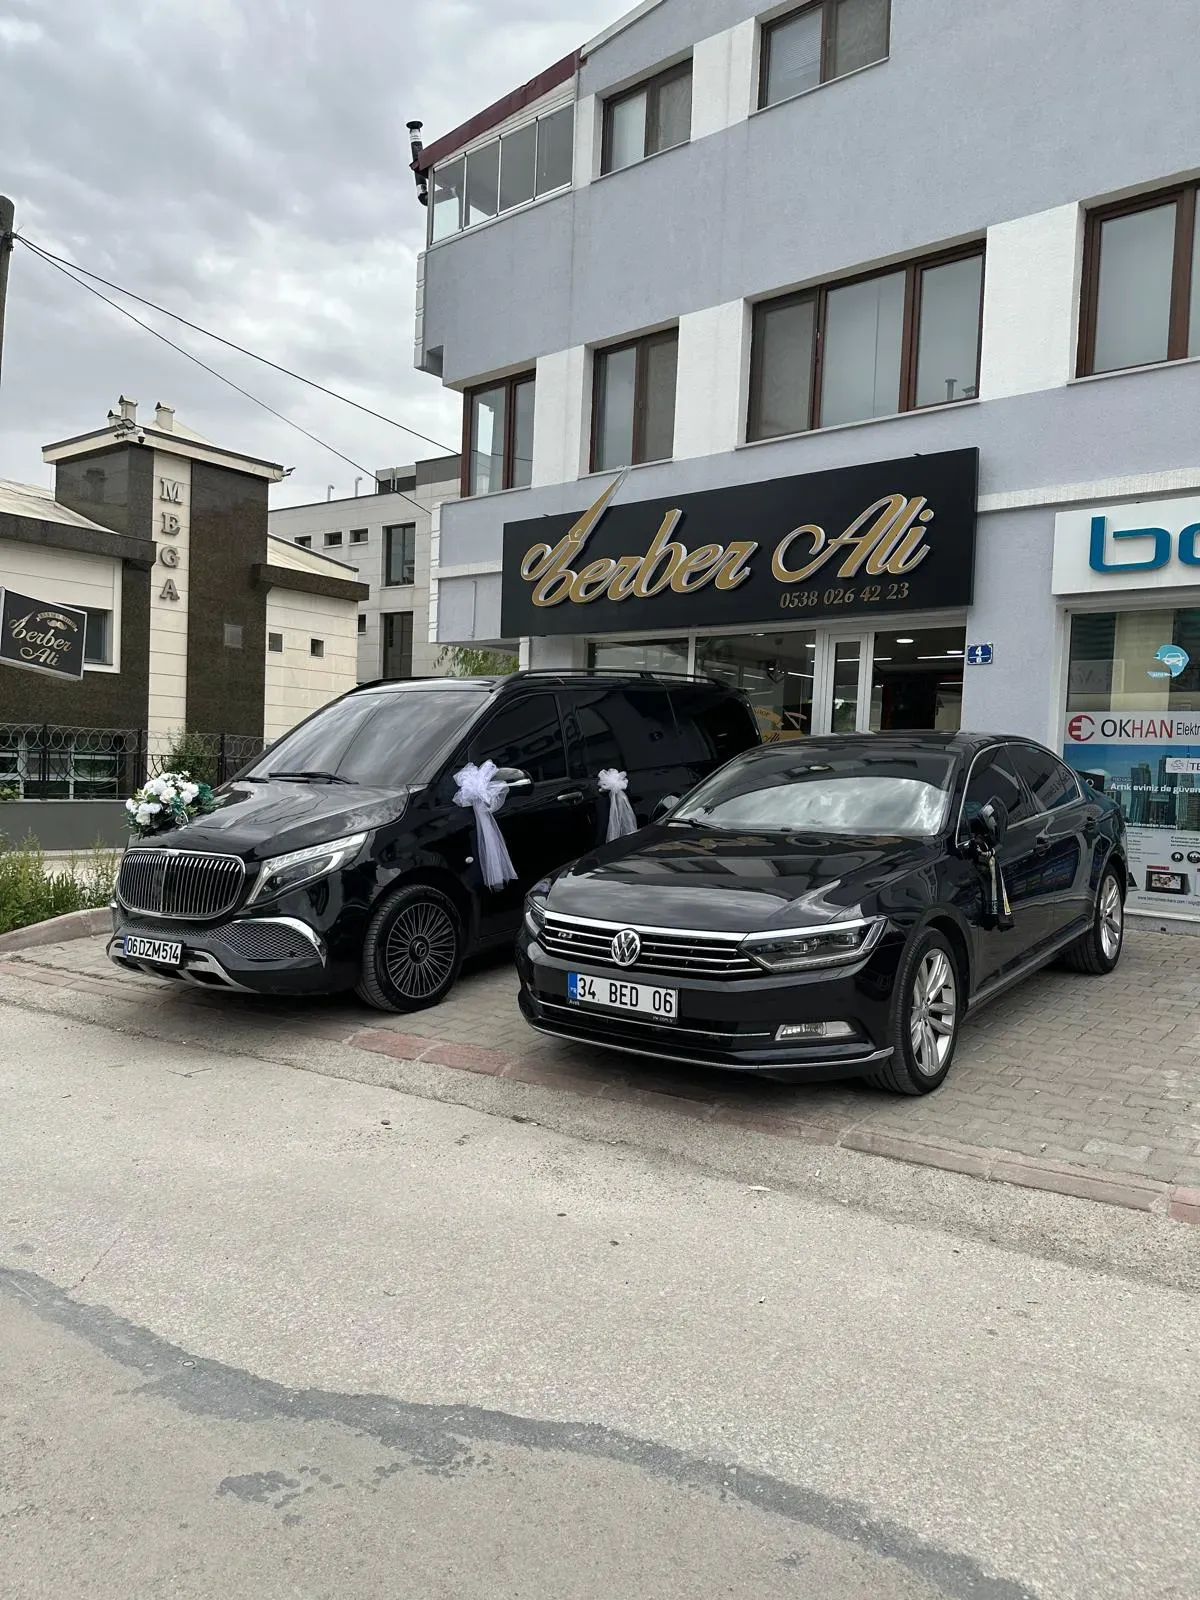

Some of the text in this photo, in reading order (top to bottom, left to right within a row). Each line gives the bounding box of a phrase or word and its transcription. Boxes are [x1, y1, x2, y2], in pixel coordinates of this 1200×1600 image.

[160, 478, 183, 601] MEGA
[771, 493, 934, 584] Ali
[779, 581, 910, 609] 0538 026 42 23
[20, 646, 60, 667] Ali
[975, 646, 983, 656] 4
[1101, 719, 1174, 738] OKHAN
[1133, 783, 1159, 793] eviniz
[1160, 784, 1172, 792] de
[578, 977, 673, 1014] 34 BED 06
